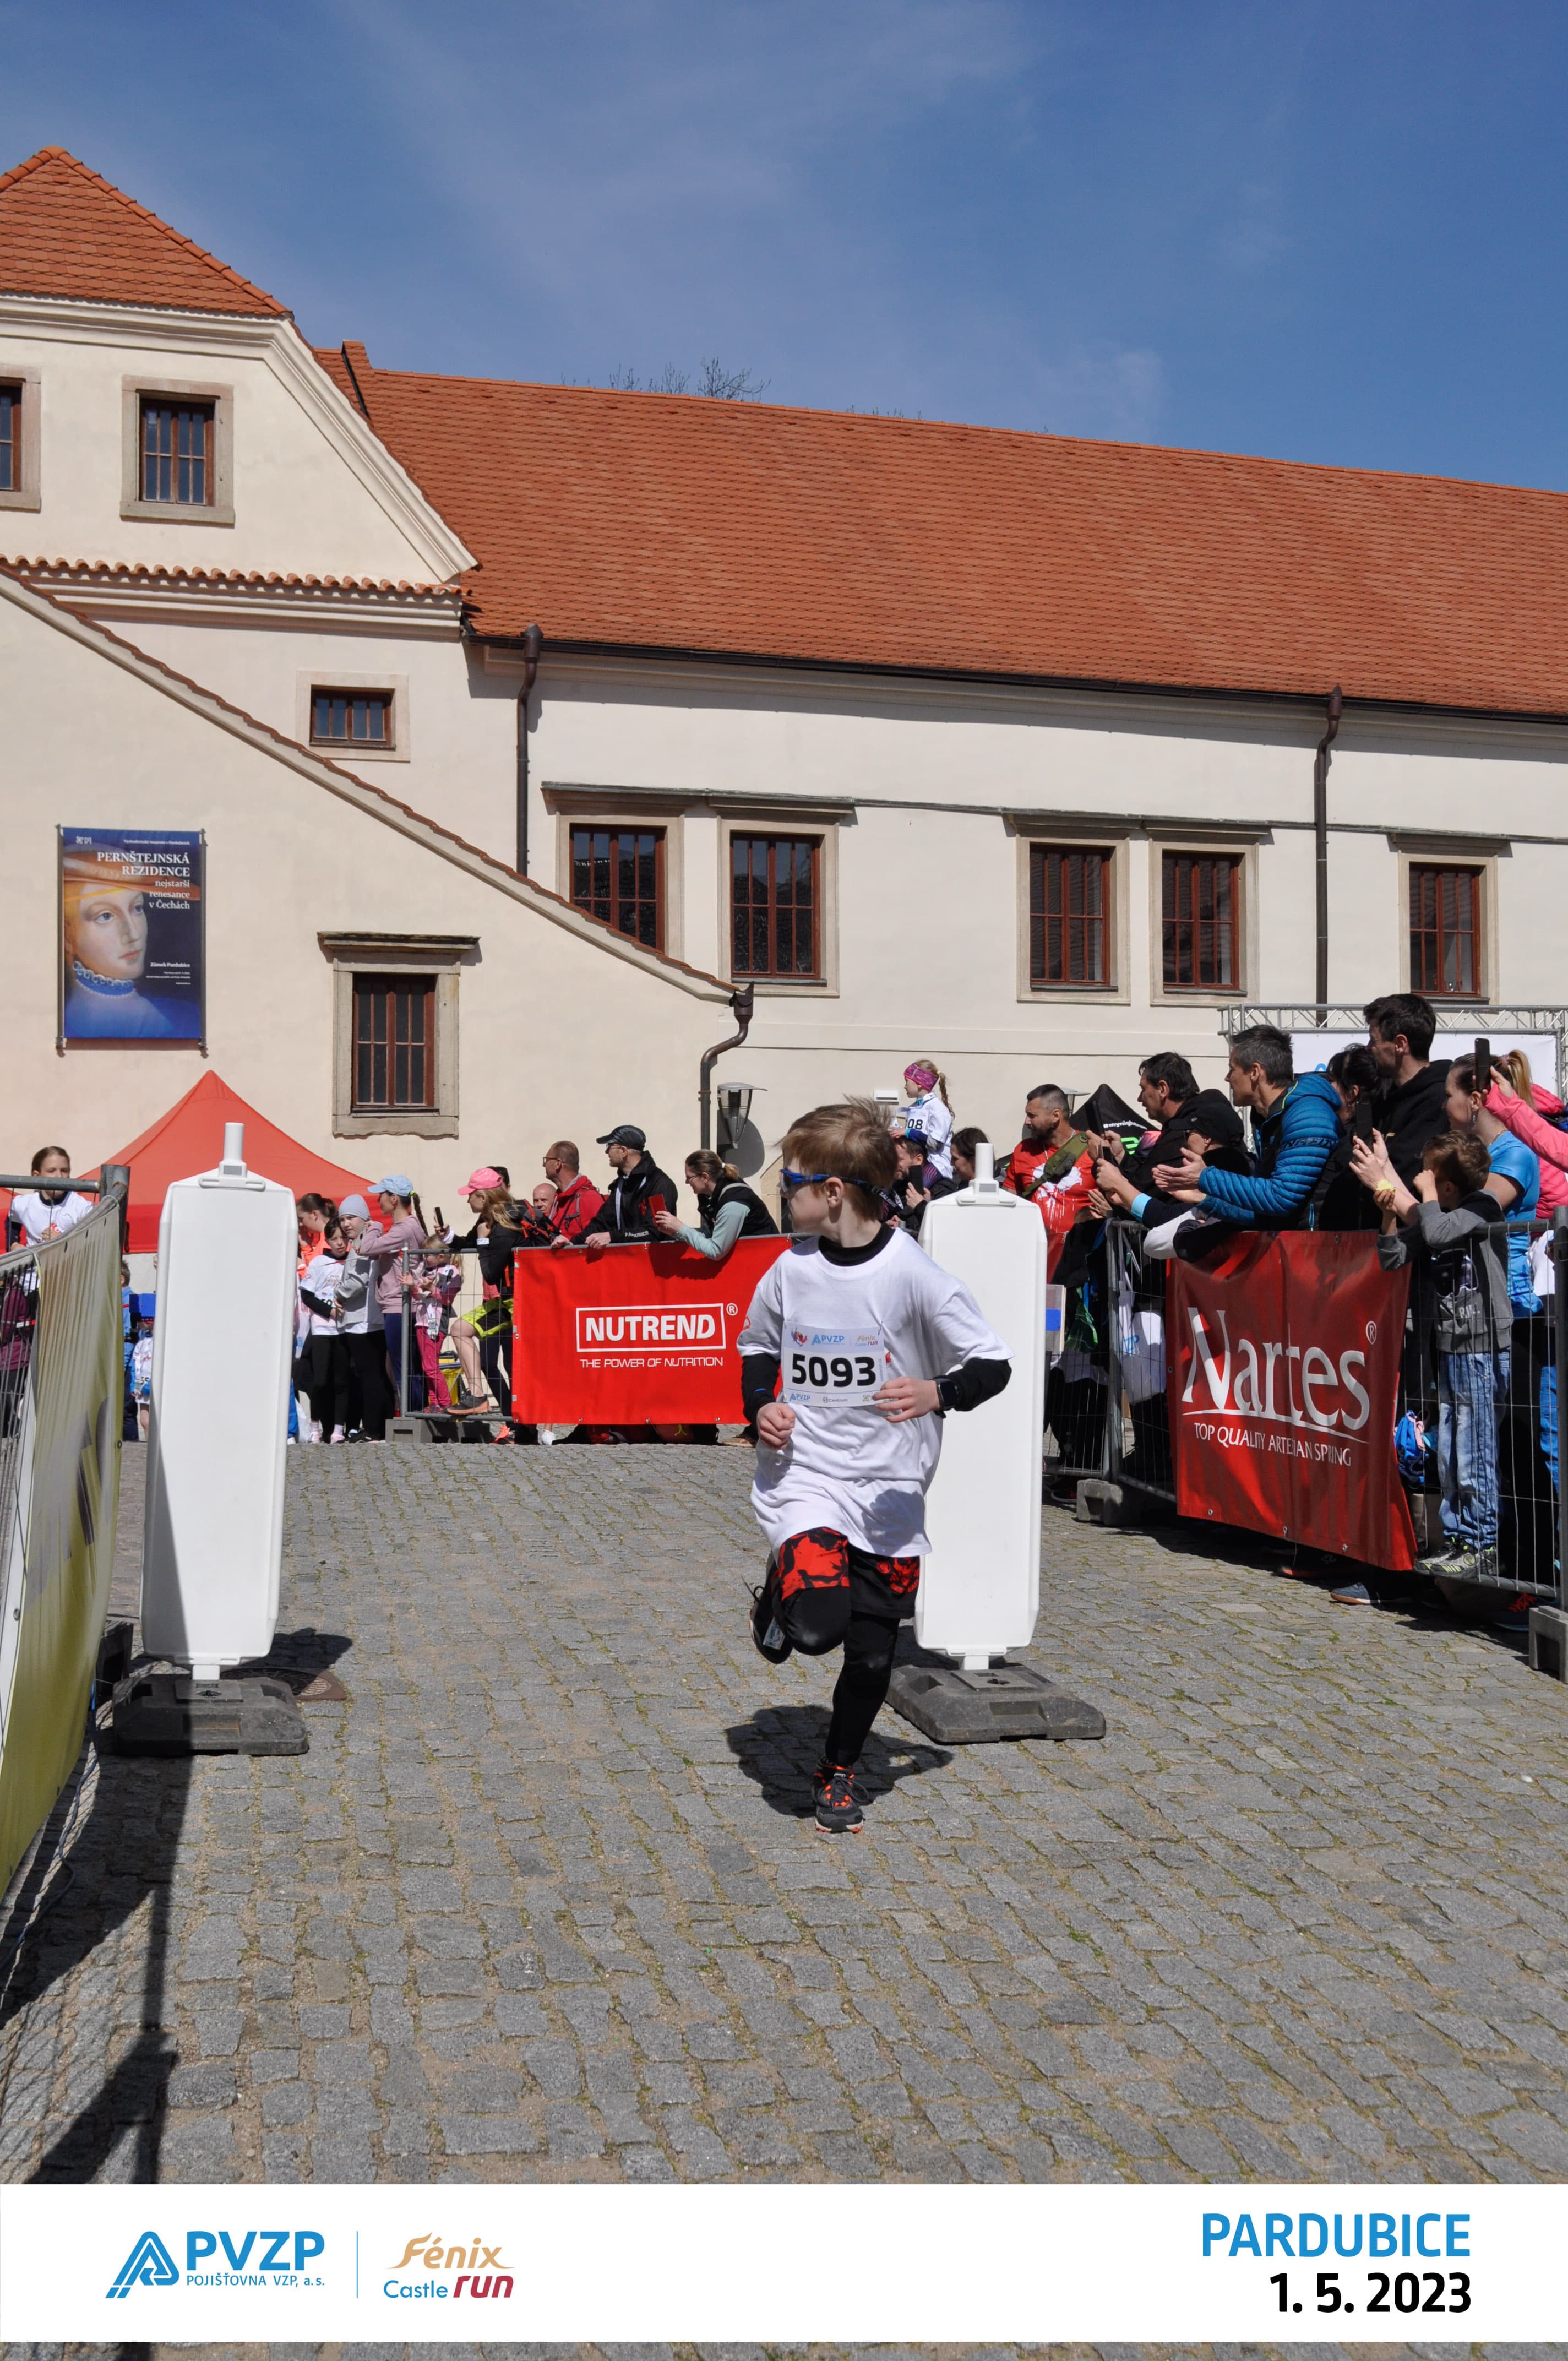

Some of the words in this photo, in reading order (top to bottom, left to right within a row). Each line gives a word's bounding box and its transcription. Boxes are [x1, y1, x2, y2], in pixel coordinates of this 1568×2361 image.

[97, 851, 190, 864] PERNŠTEJNSKÁ
[122, 866, 190, 877] REZIDENCE
[155, 879, 190, 888] nejstarší
[156, 900, 190, 909] Čechách
[586, 1314, 715, 1341] NUTREND
[580, 1359, 601, 1368] THE
[604, 1358, 644, 1368] POWER
[647, 1358, 662, 1367] OF
[664, 1357, 723, 1367] NUTRITION
[1181, 1307, 1370, 1430] Nartes
[792, 1353, 876, 1387] 5093
[1194, 1422, 1215, 1441] TOP
[1217, 1426, 1265, 1450] QUALITY
[1315, 1443, 1351, 1466] SPRING
